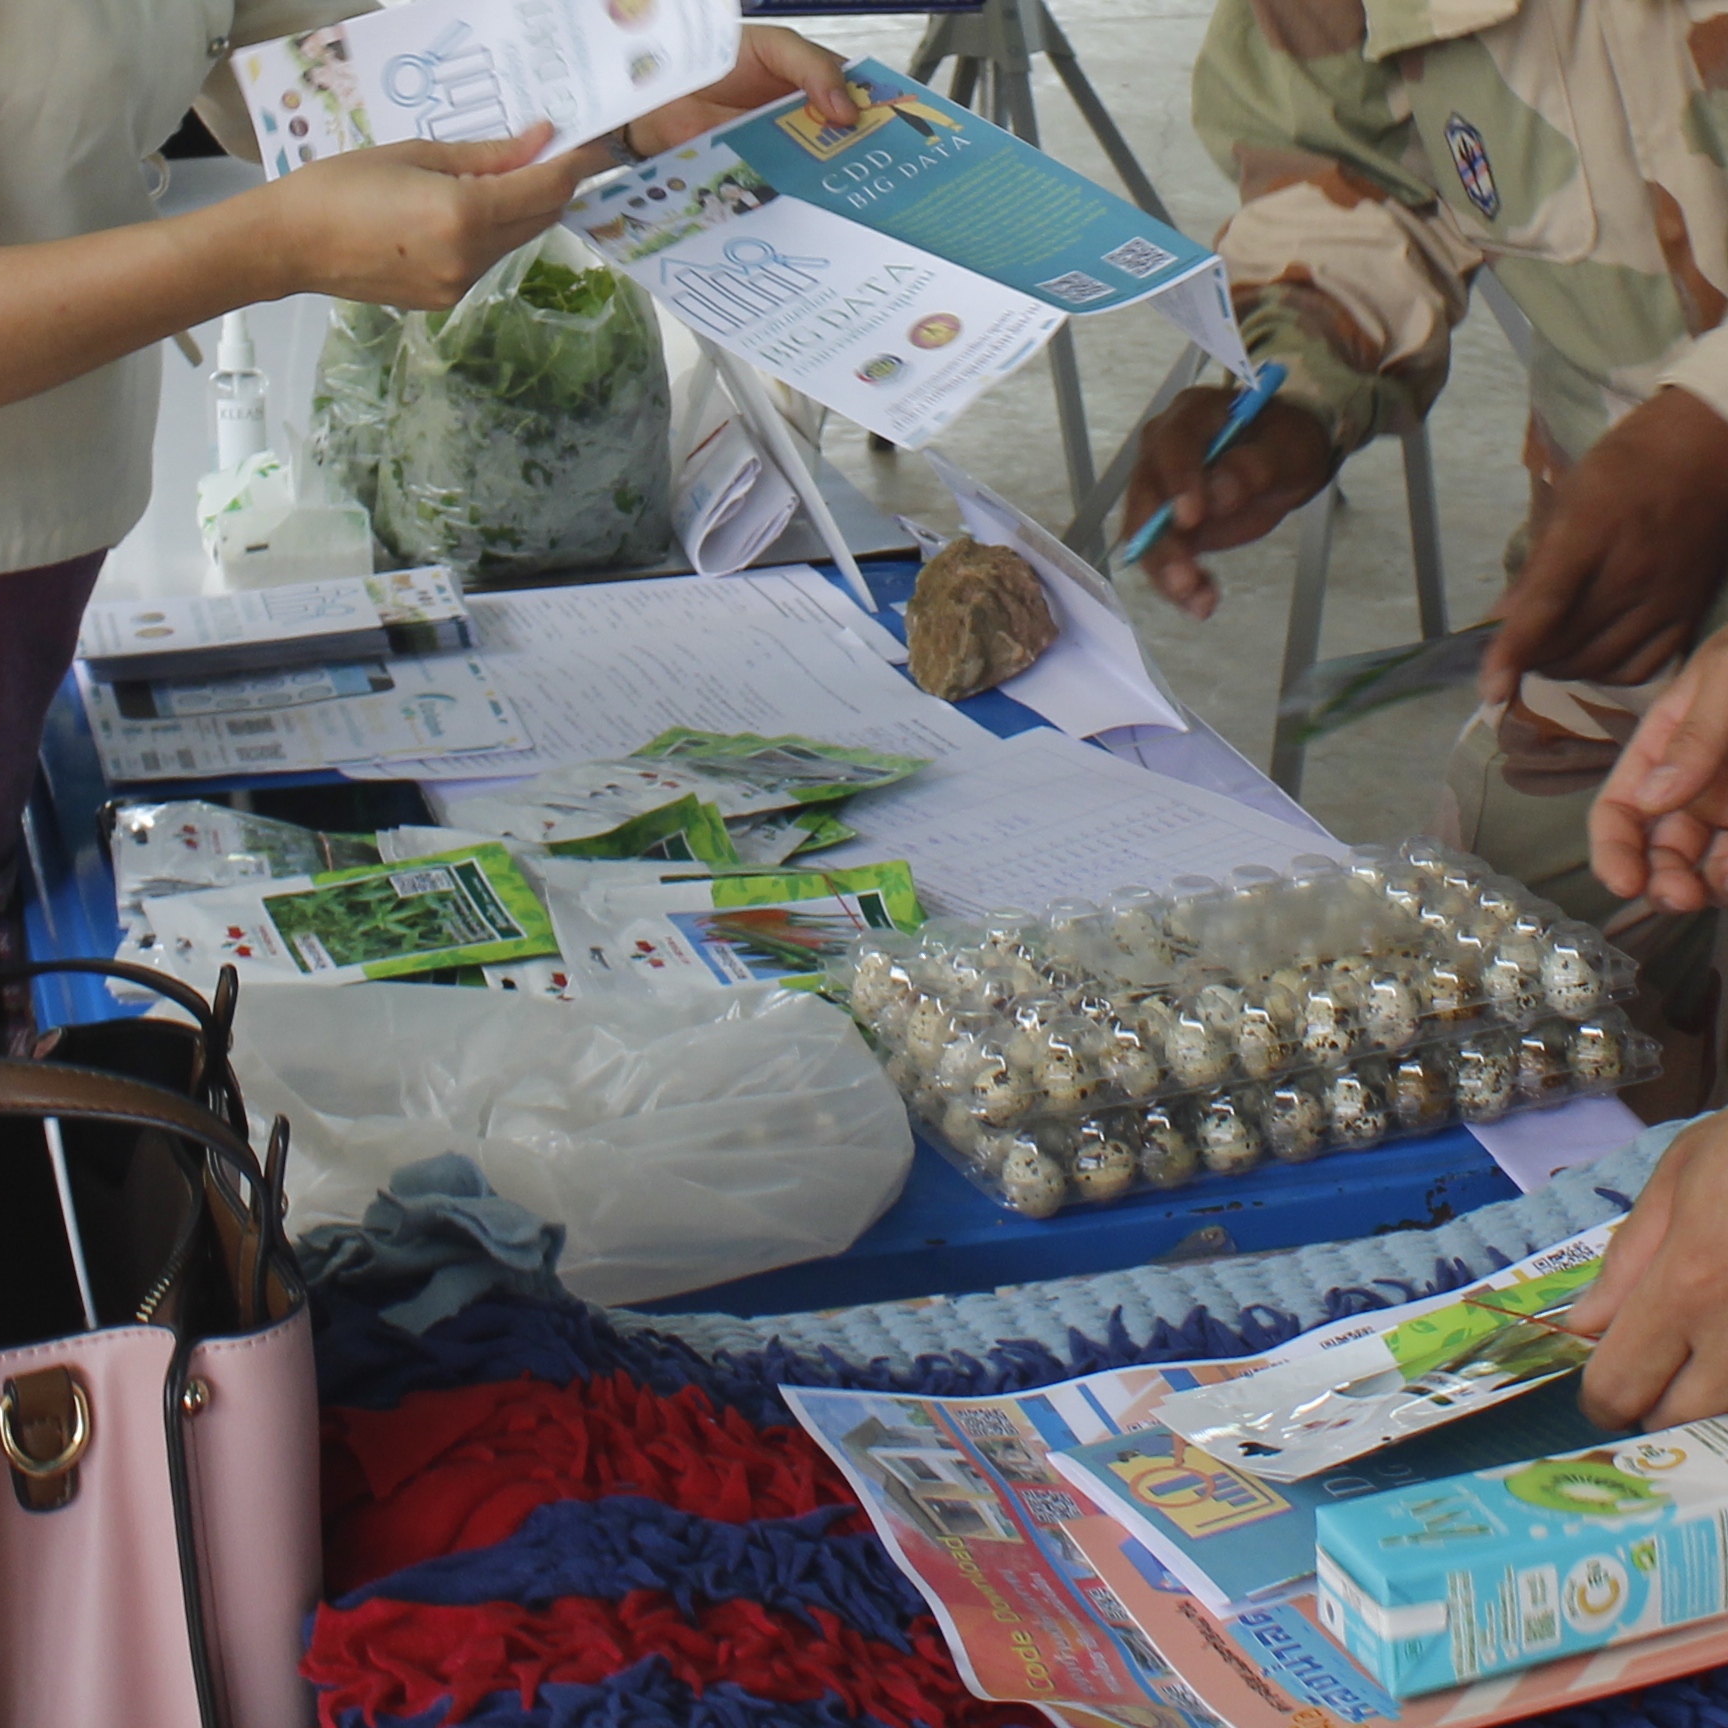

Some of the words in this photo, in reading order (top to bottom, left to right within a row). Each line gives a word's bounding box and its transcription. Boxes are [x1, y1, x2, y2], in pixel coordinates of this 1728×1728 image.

[821, 149, 894, 195] CDD
[846, 175, 896, 210] BIG
[897, 135, 972, 179] DATA
[757, 324, 822, 368] BIG
[818, 263, 917, 330] DATA
[1009, 1629, 1056, 1692] Code
